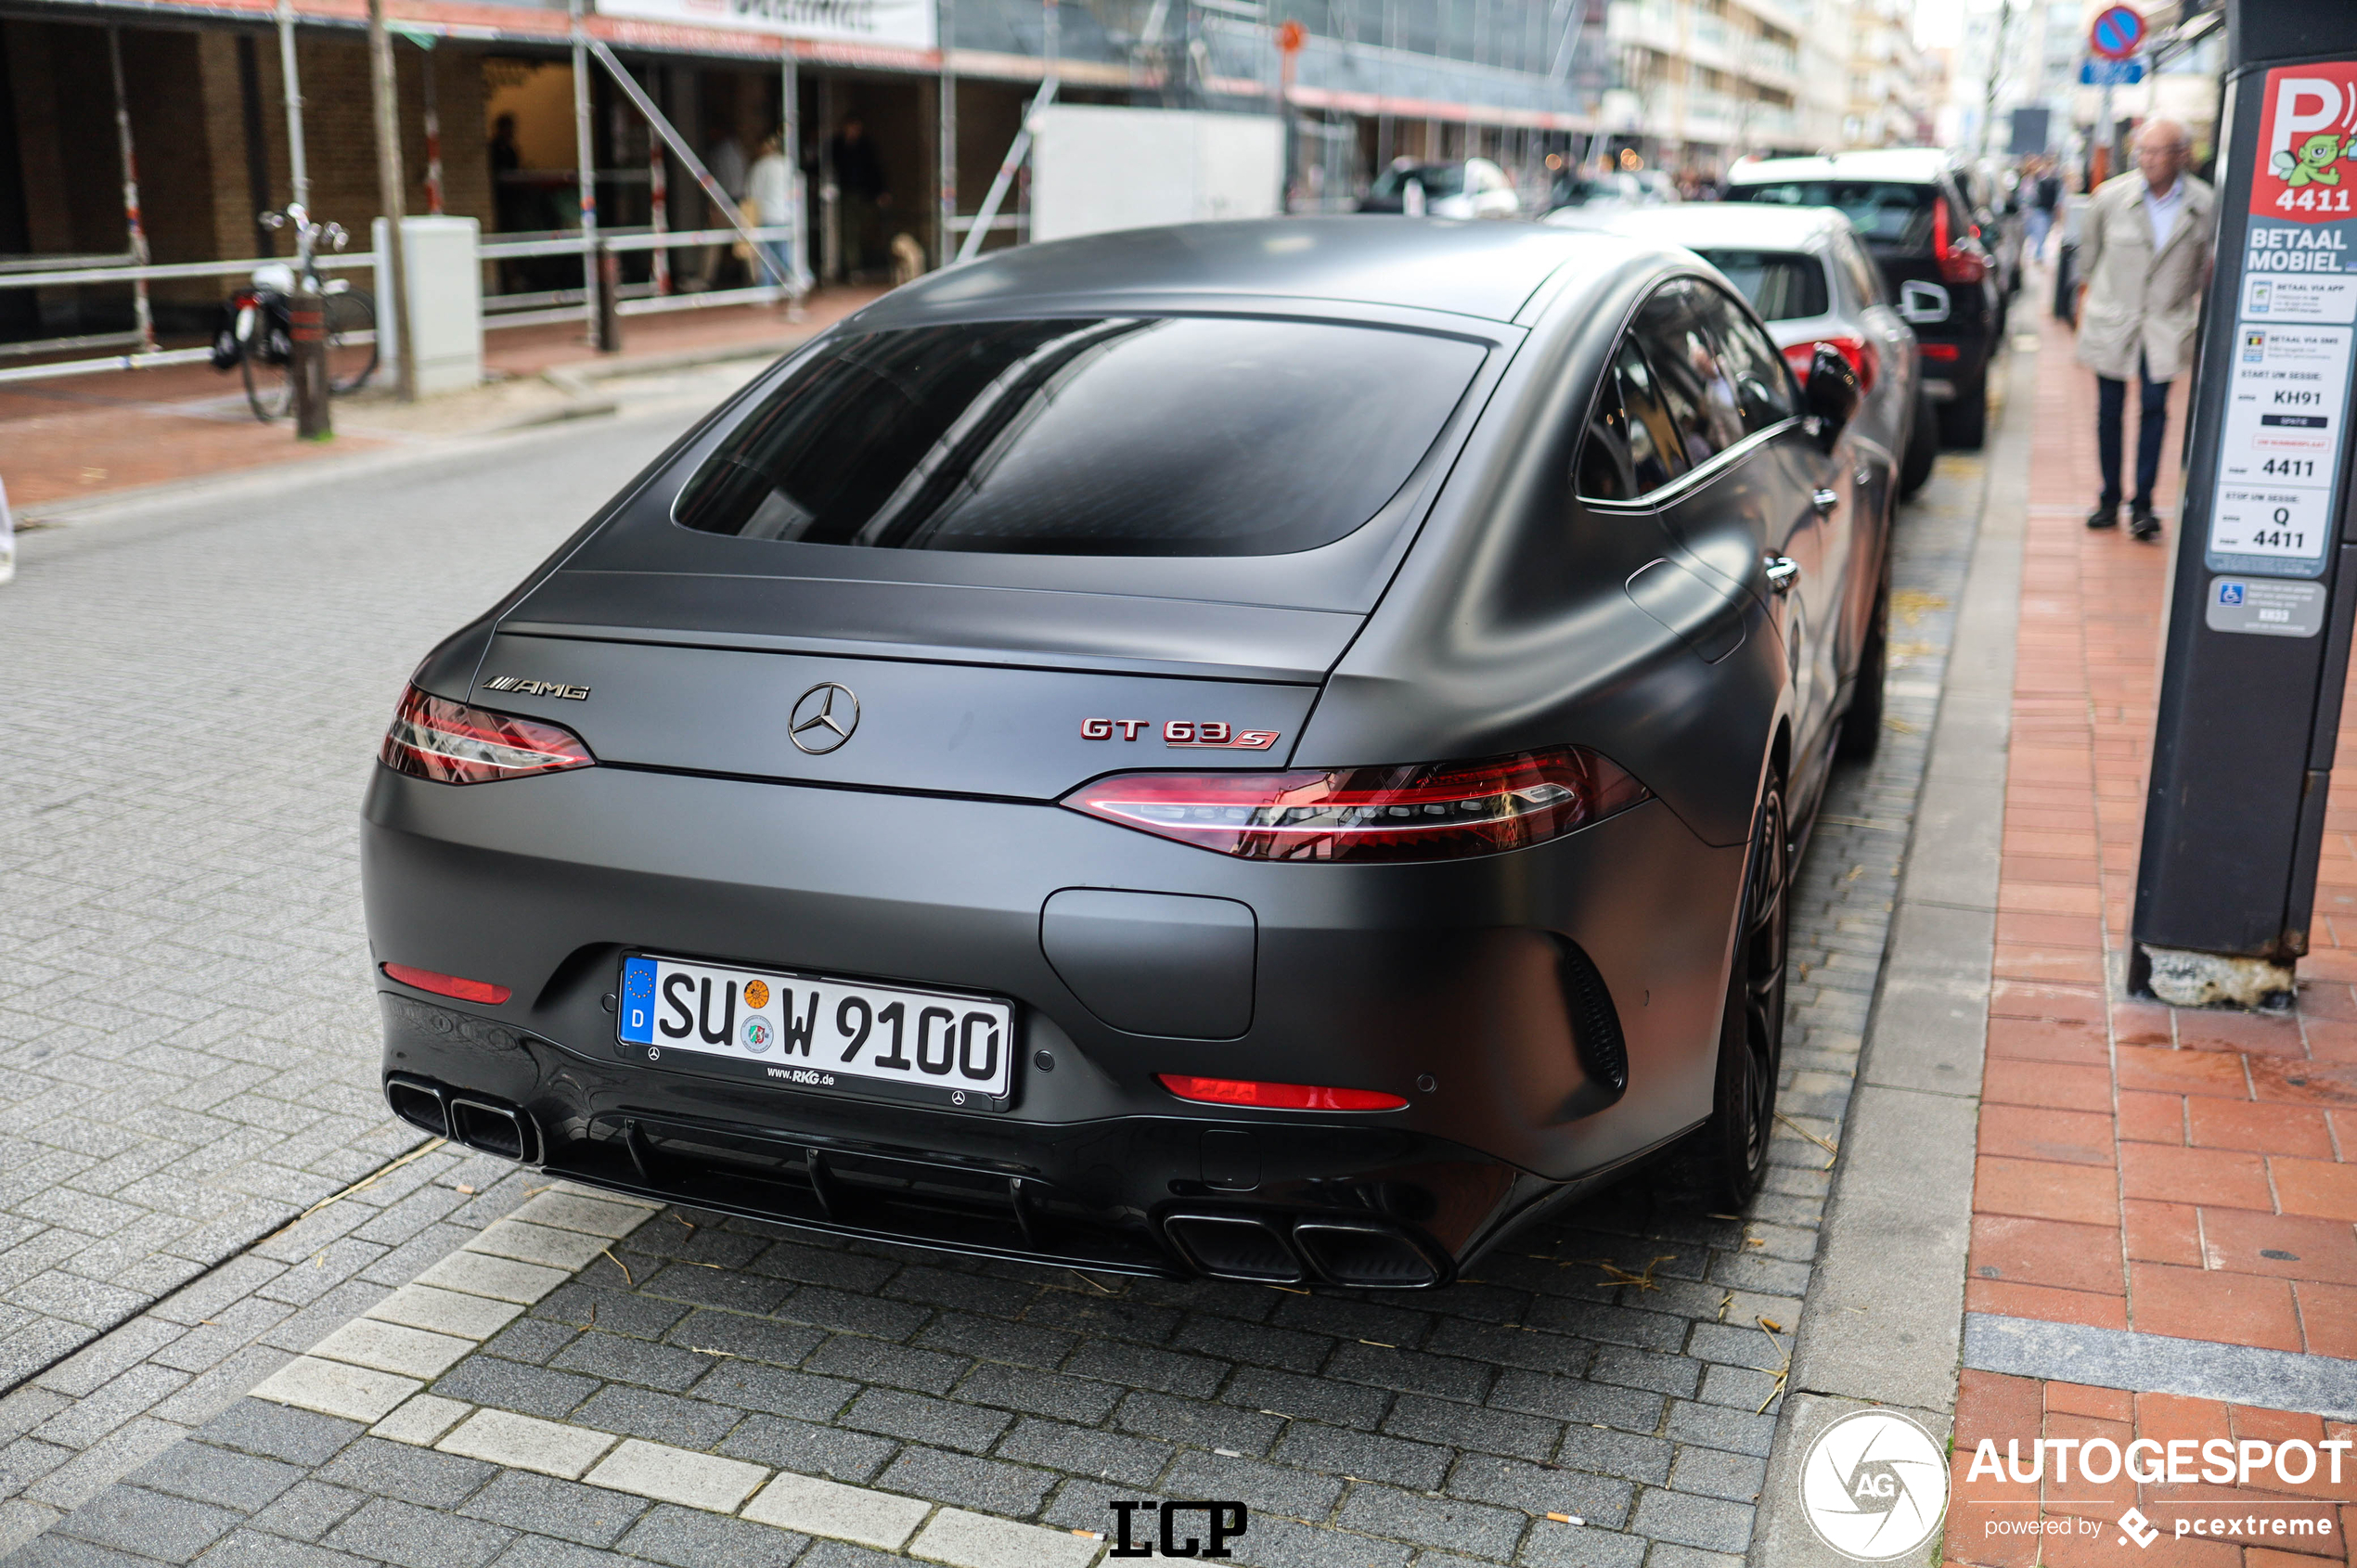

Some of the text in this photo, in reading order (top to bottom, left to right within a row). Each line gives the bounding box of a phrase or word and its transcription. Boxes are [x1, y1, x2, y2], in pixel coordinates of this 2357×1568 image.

[2275, 188, 2351, 212] 4411
[2249, 228, 2348, 251] BETAAL
[2247, 250, 2342, 272] MOBIEL
[2276, 283, 2308, 291] BETAAL
[2241, 369, 2270, 379] START
[2273, 390, 2322, 405] KH91
[2262, 458, 2314, 477] 4411
[2273, 507, 2290, 527] Q
[2253, 530, 2304, 548] 4411
[511, 679, 591, 701] AMG
[1080, 717, 1151, 742] GT
[631, 1009, 645, 1029] D
[658, 971, 1000, 1081] SU W 9100
[766, 1067, 835, 1086] www.RKG.de
